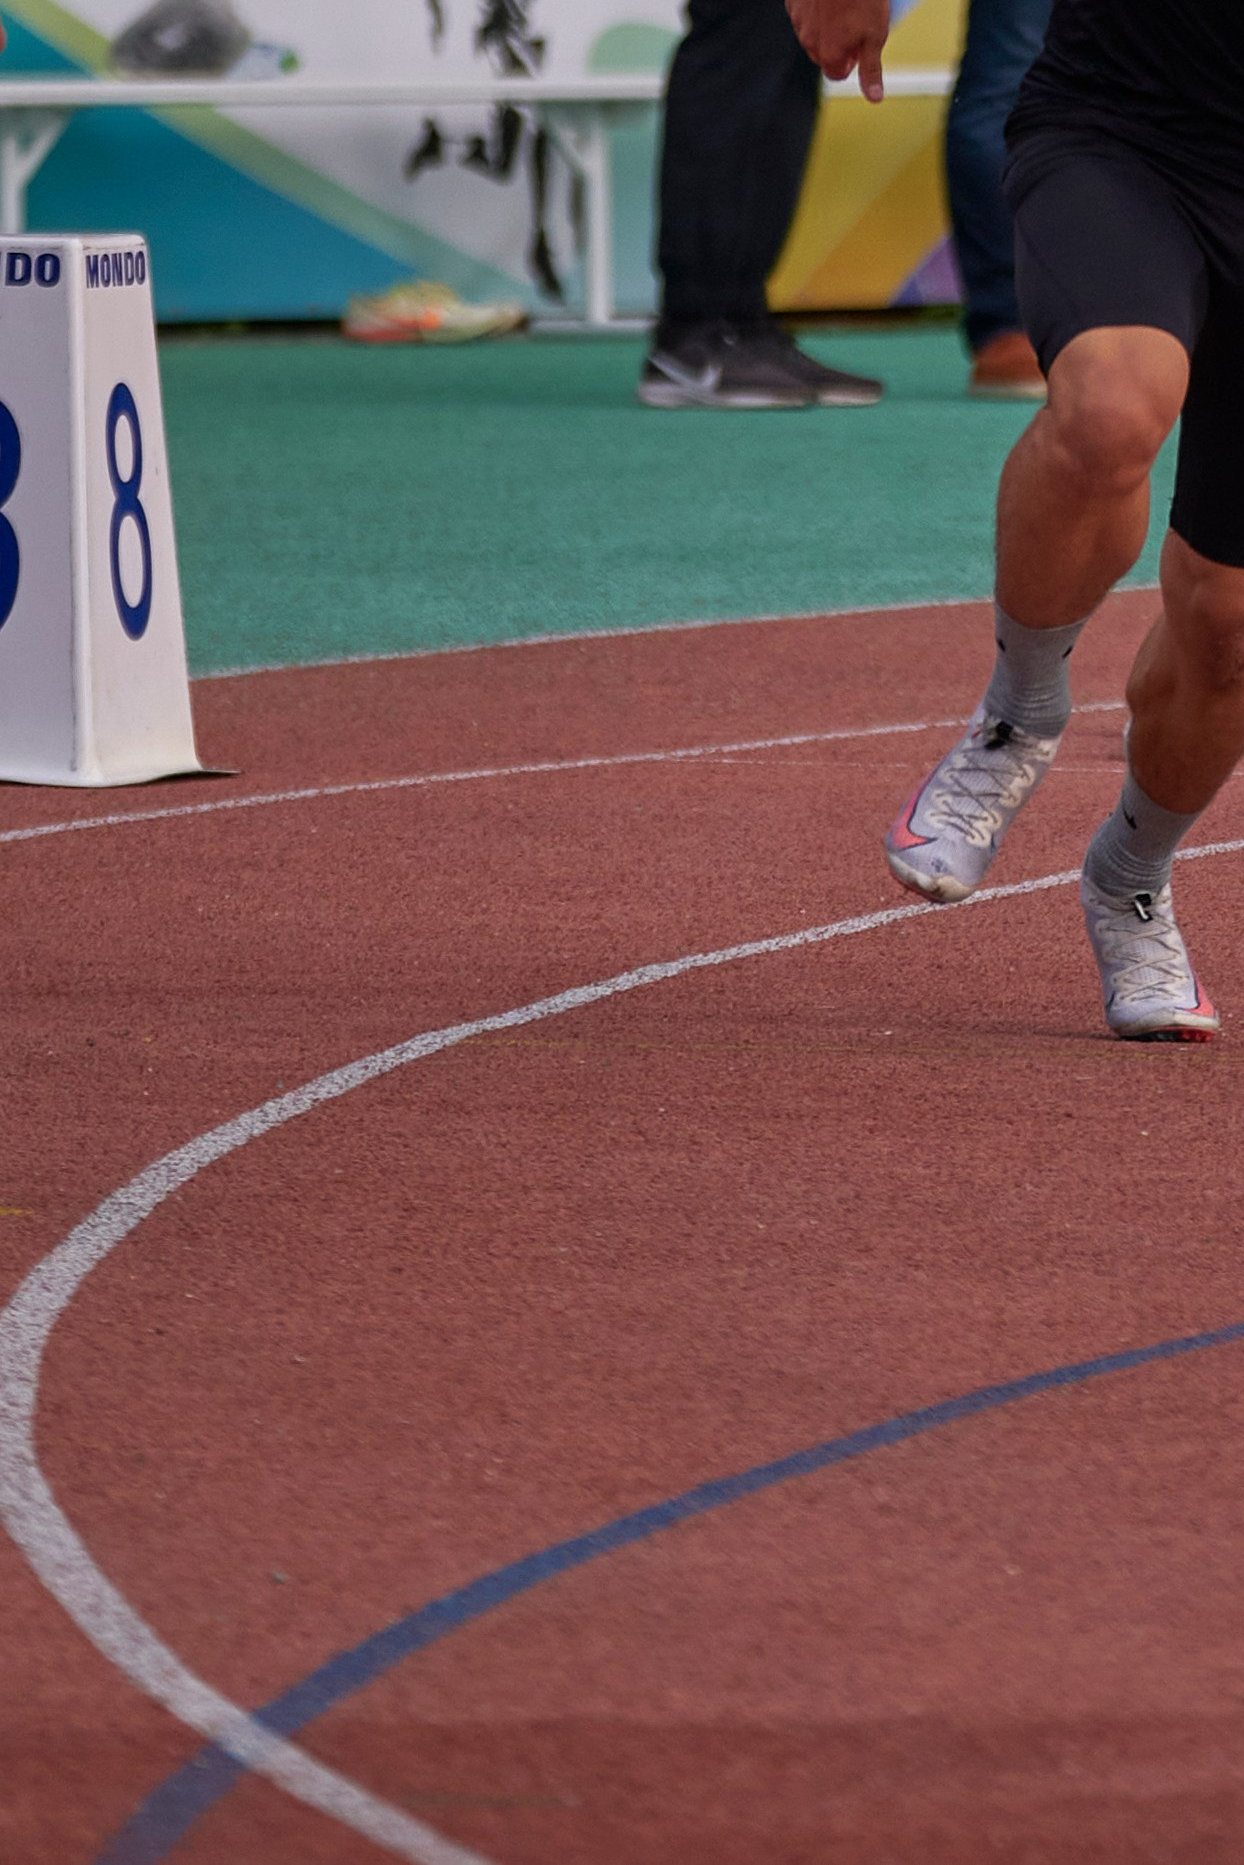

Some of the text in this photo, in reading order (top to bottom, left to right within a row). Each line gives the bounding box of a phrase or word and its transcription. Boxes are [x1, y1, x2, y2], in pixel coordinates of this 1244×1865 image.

[0, 252, 61, 288] DO
[86, 251, 146, 289] MONDO
[106, 383, 152, 641] 8
